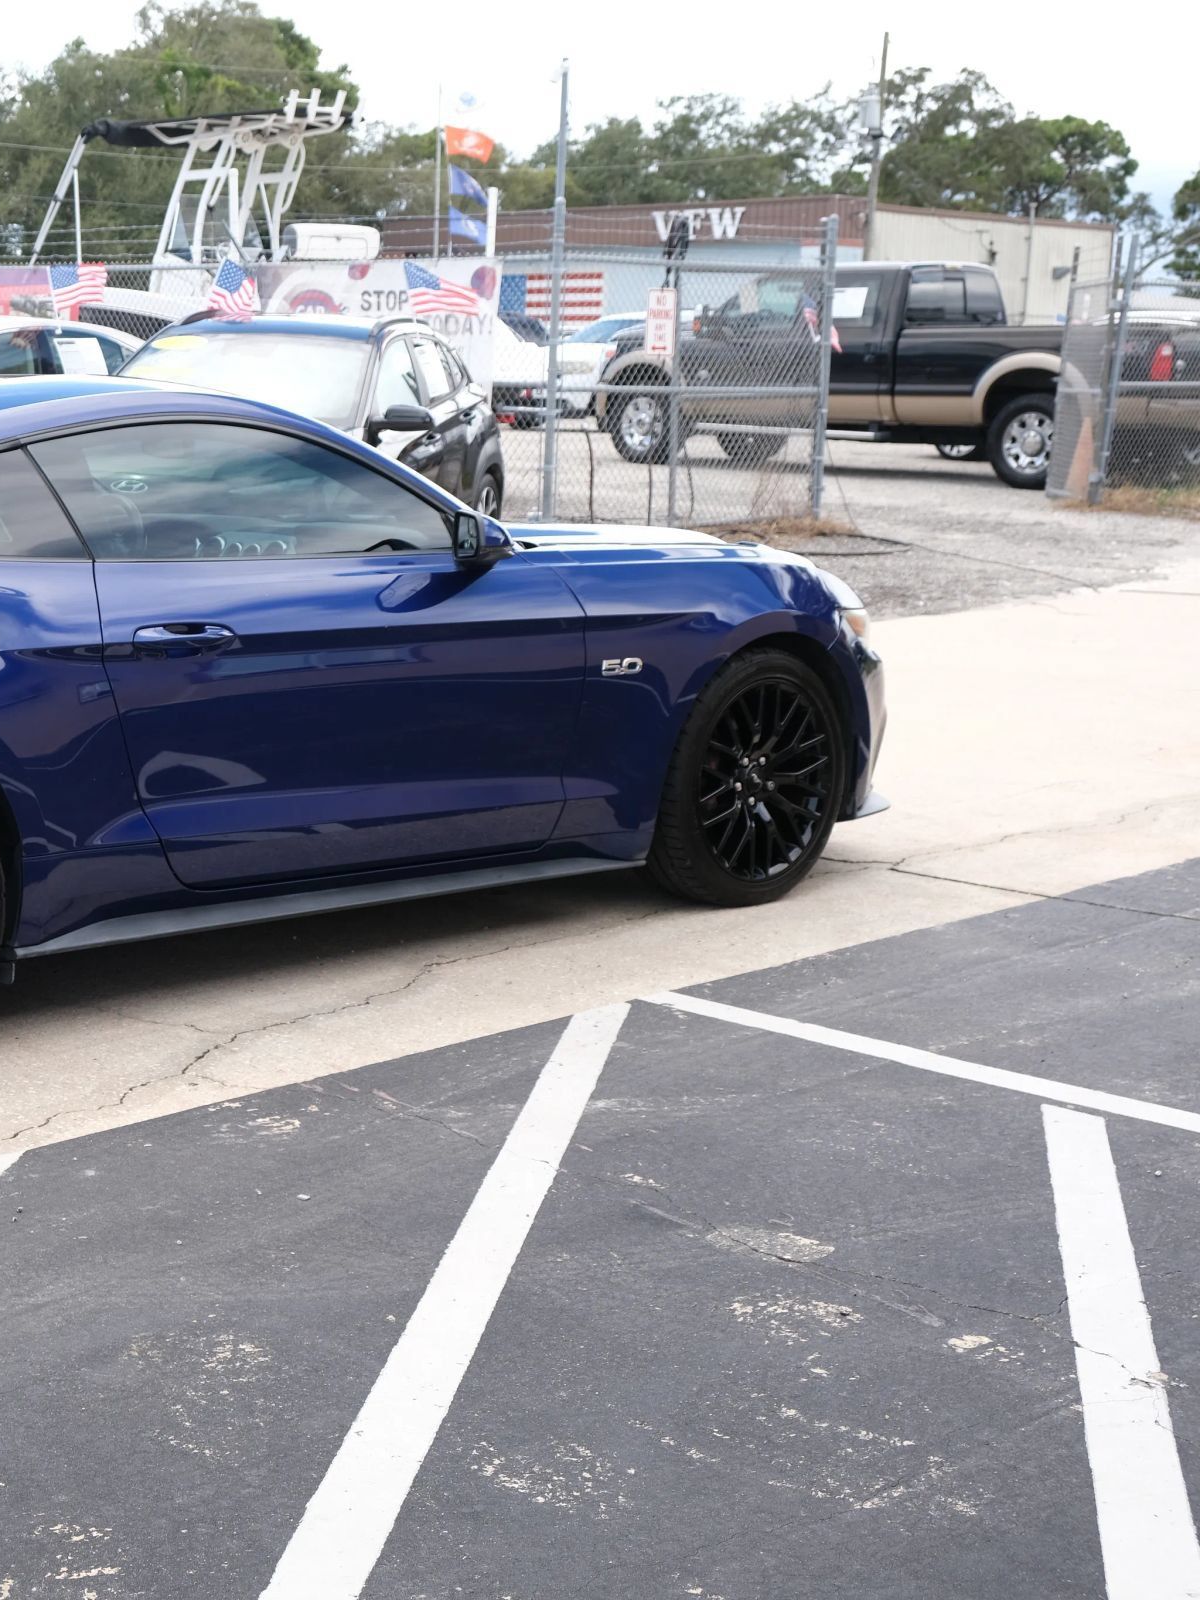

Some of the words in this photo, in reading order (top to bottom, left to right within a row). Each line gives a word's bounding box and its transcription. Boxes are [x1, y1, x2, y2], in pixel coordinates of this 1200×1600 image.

[652, 206, 747, 242] VFW
[360, 289, 408, 312] STOP
[656, 294, 667, 306] NO
[423, 313, 493, 335] ODAY!
